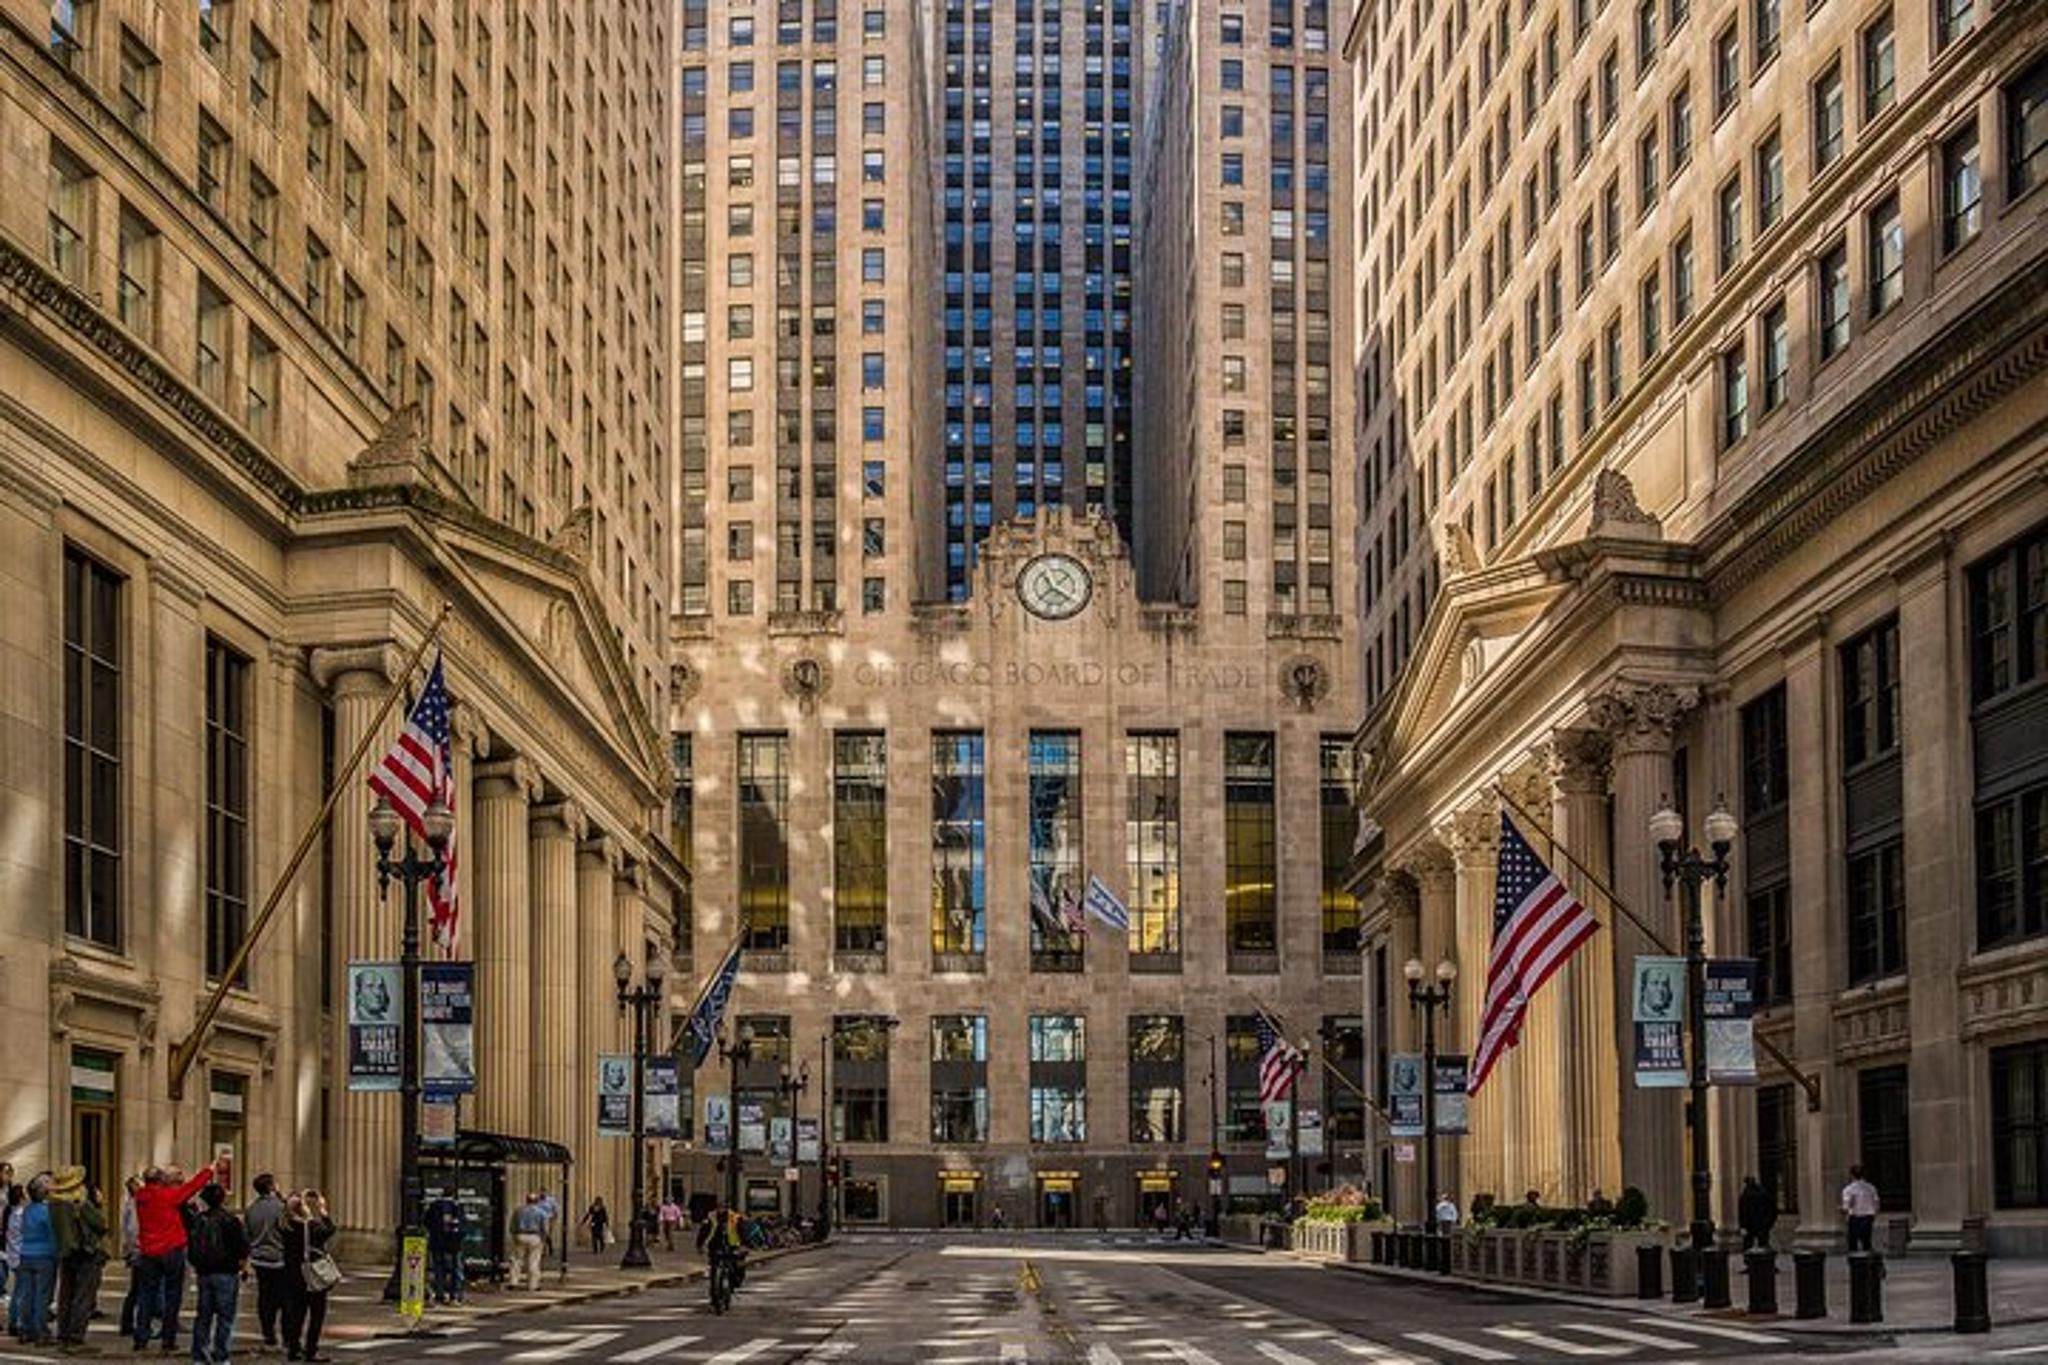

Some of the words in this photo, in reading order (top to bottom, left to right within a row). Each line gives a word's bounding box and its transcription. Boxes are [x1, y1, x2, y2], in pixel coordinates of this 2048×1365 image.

[855, 661, 994, 687] CHICAGO
[1006, 662, 1101, 686] BOARD
[1117, 662, 1155, 687] OF
[1173, 663, 1260, 688] TRADE
